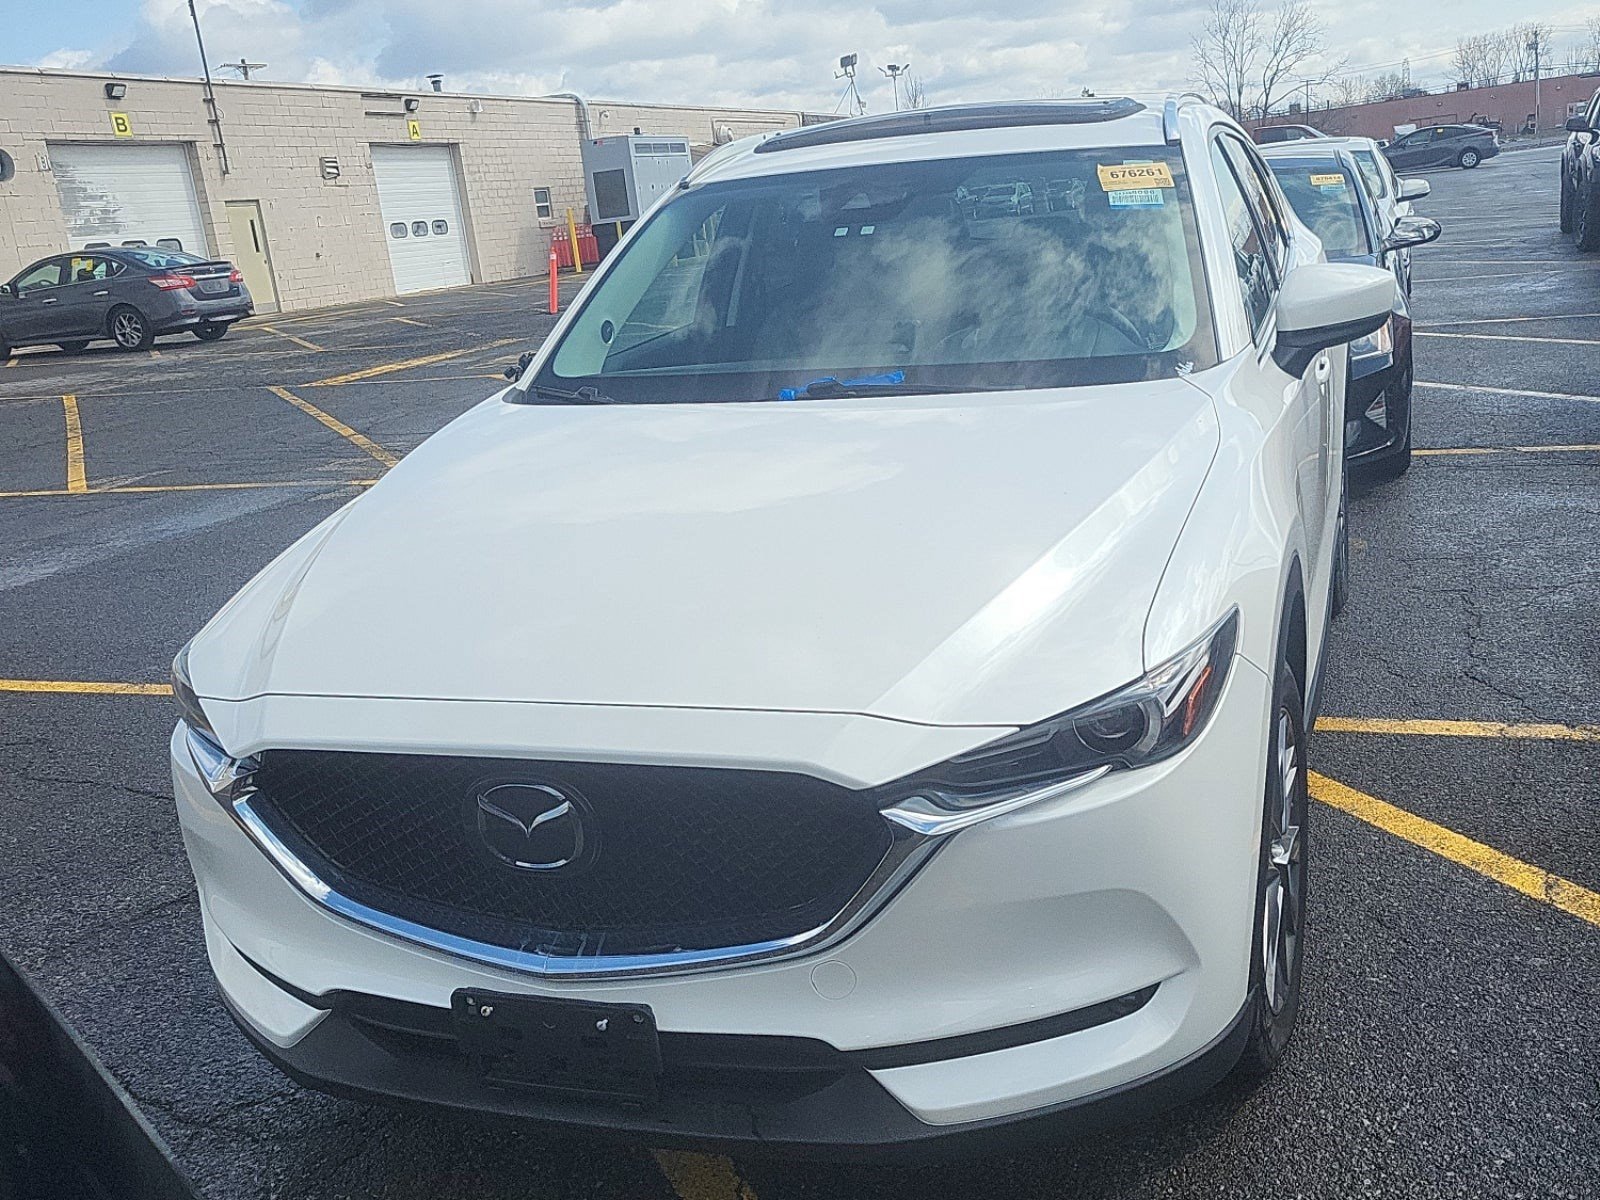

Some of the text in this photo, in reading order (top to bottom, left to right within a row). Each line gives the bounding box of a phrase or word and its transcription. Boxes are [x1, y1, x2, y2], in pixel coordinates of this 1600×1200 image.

[114, 116, 128, 132] B
[412, 124, 420, 137] A
[1110, 168, 1163, 179] 676261
